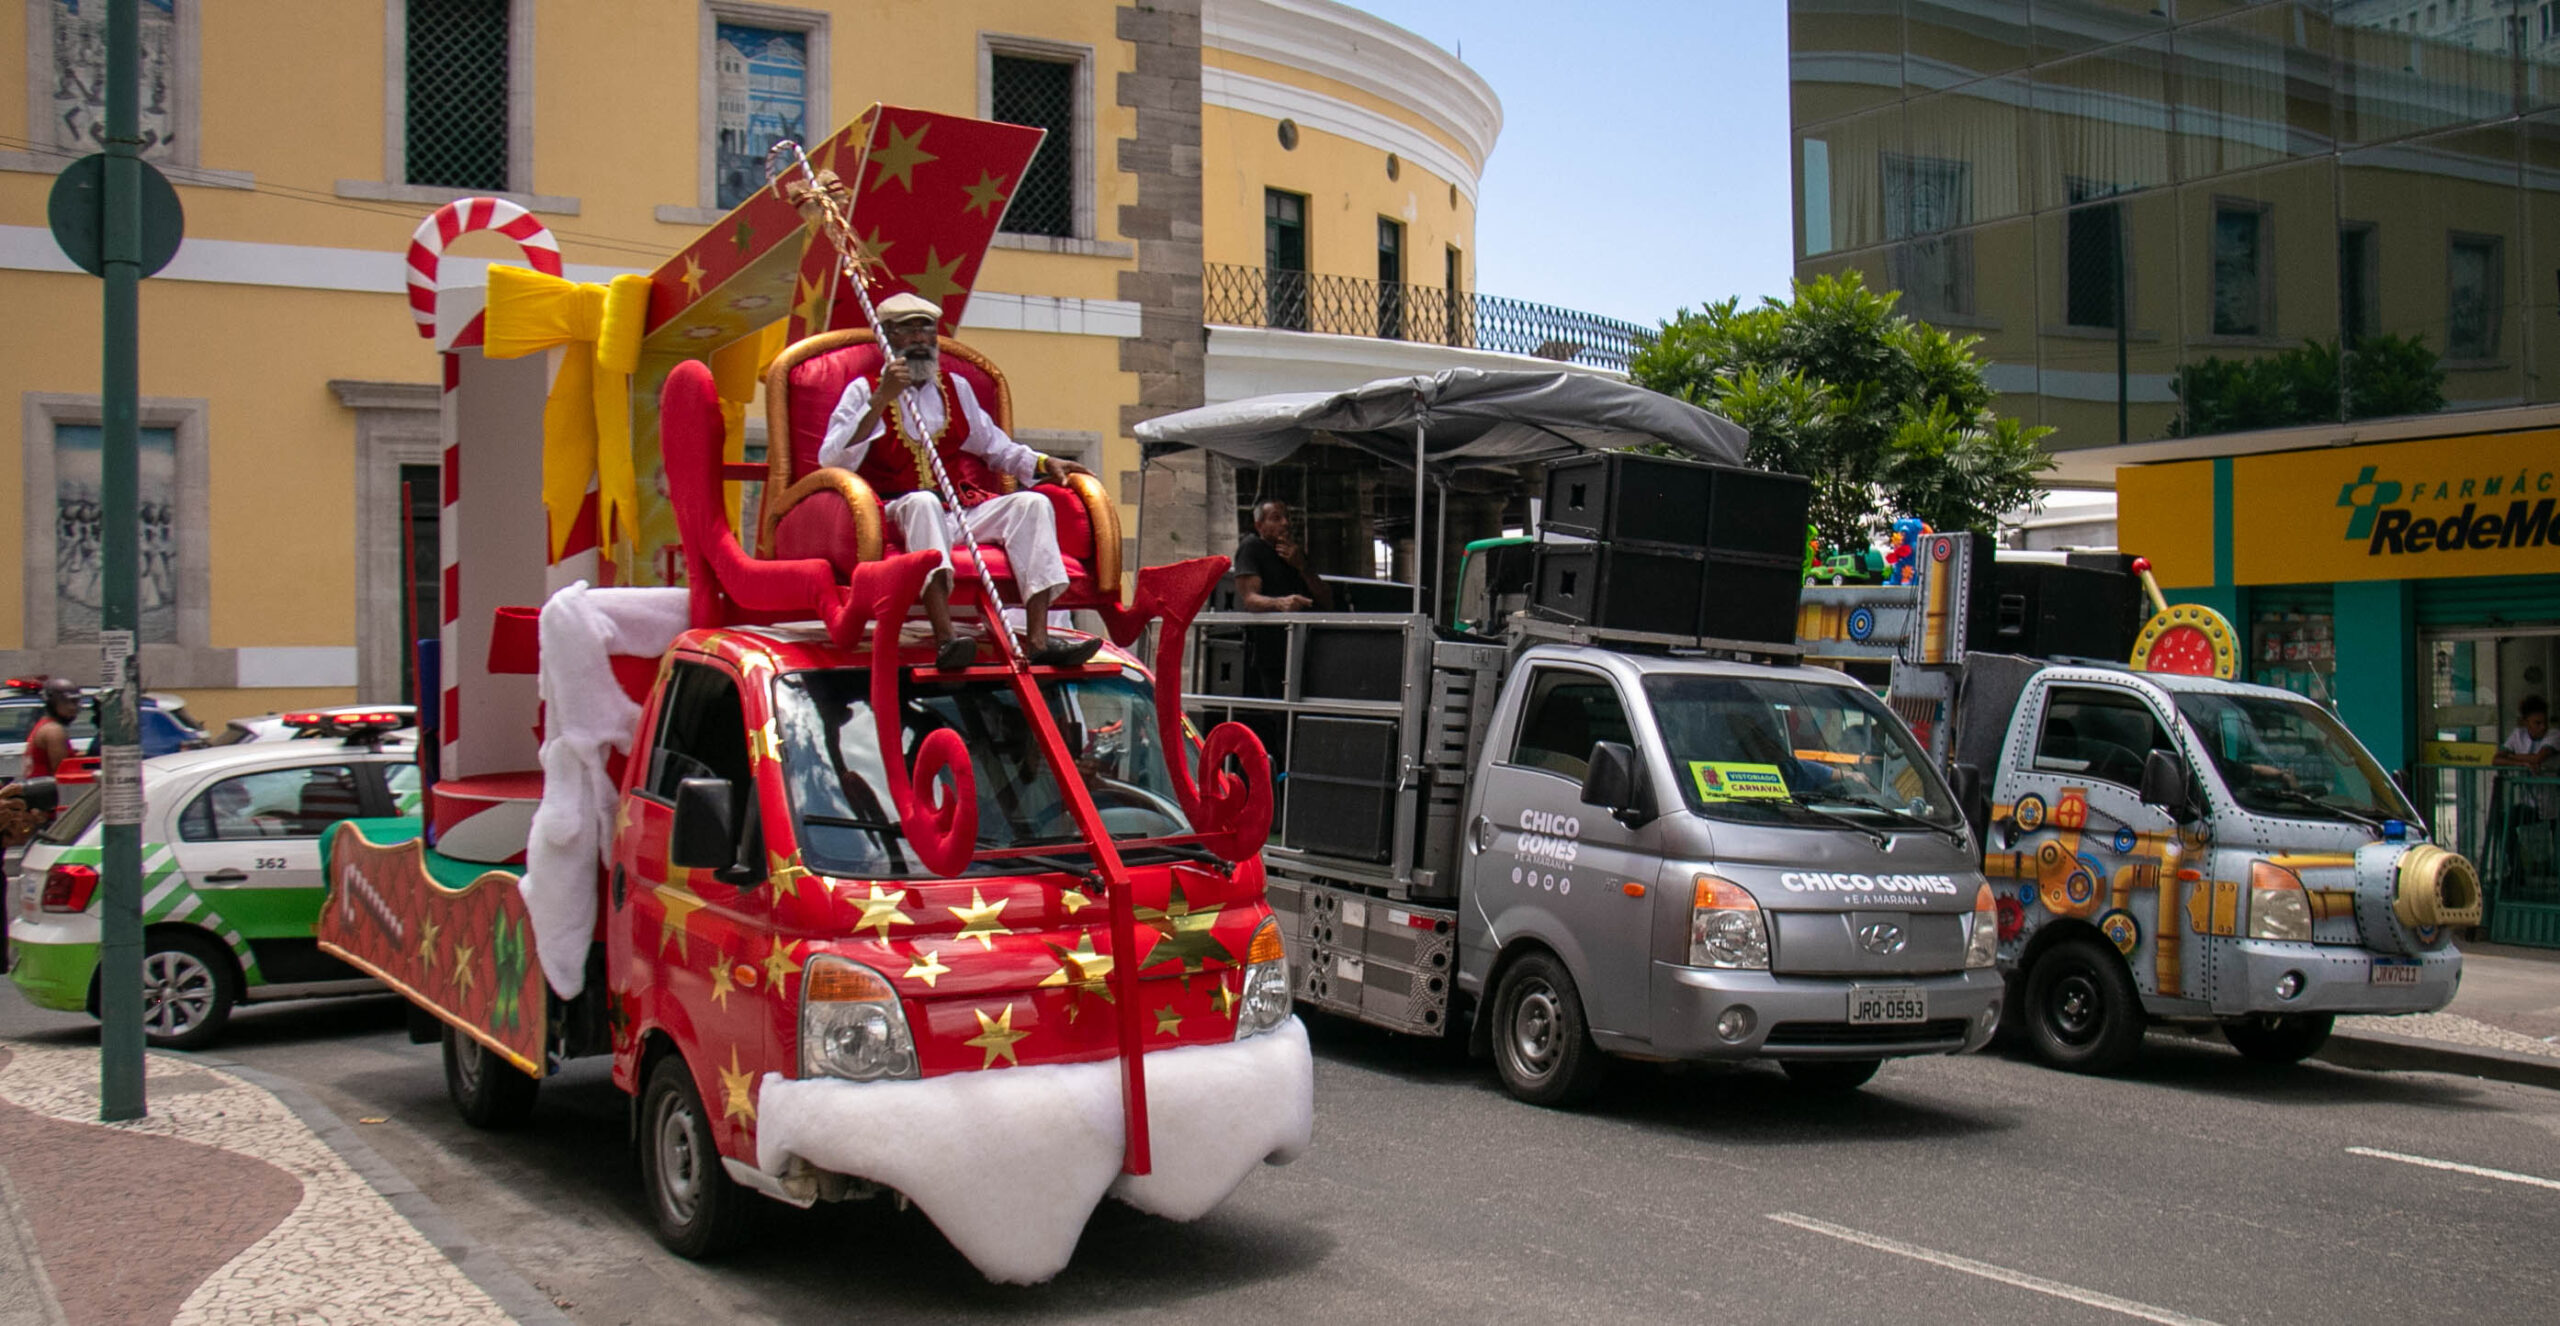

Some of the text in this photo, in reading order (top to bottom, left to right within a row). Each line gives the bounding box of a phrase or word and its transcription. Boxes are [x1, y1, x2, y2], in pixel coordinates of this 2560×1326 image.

[1730, 773, 1778, 782] VISTORIADO
[1731, 784, 1785, 793] CARNAVAL
[1520, 808, 1580, 838] CHICO
[1517, 833, 1579, 861] GOMES
[255, 857, 287, 869] 362
[1526, 854, 1532, 865] A
[1533, 854, 1567, 871] MARANA
[1781, 872, 1957, 895] CHICO GOMES
[1863, 895, 1872, 905] A
[1874, 895, 1919, 905] MARANA
